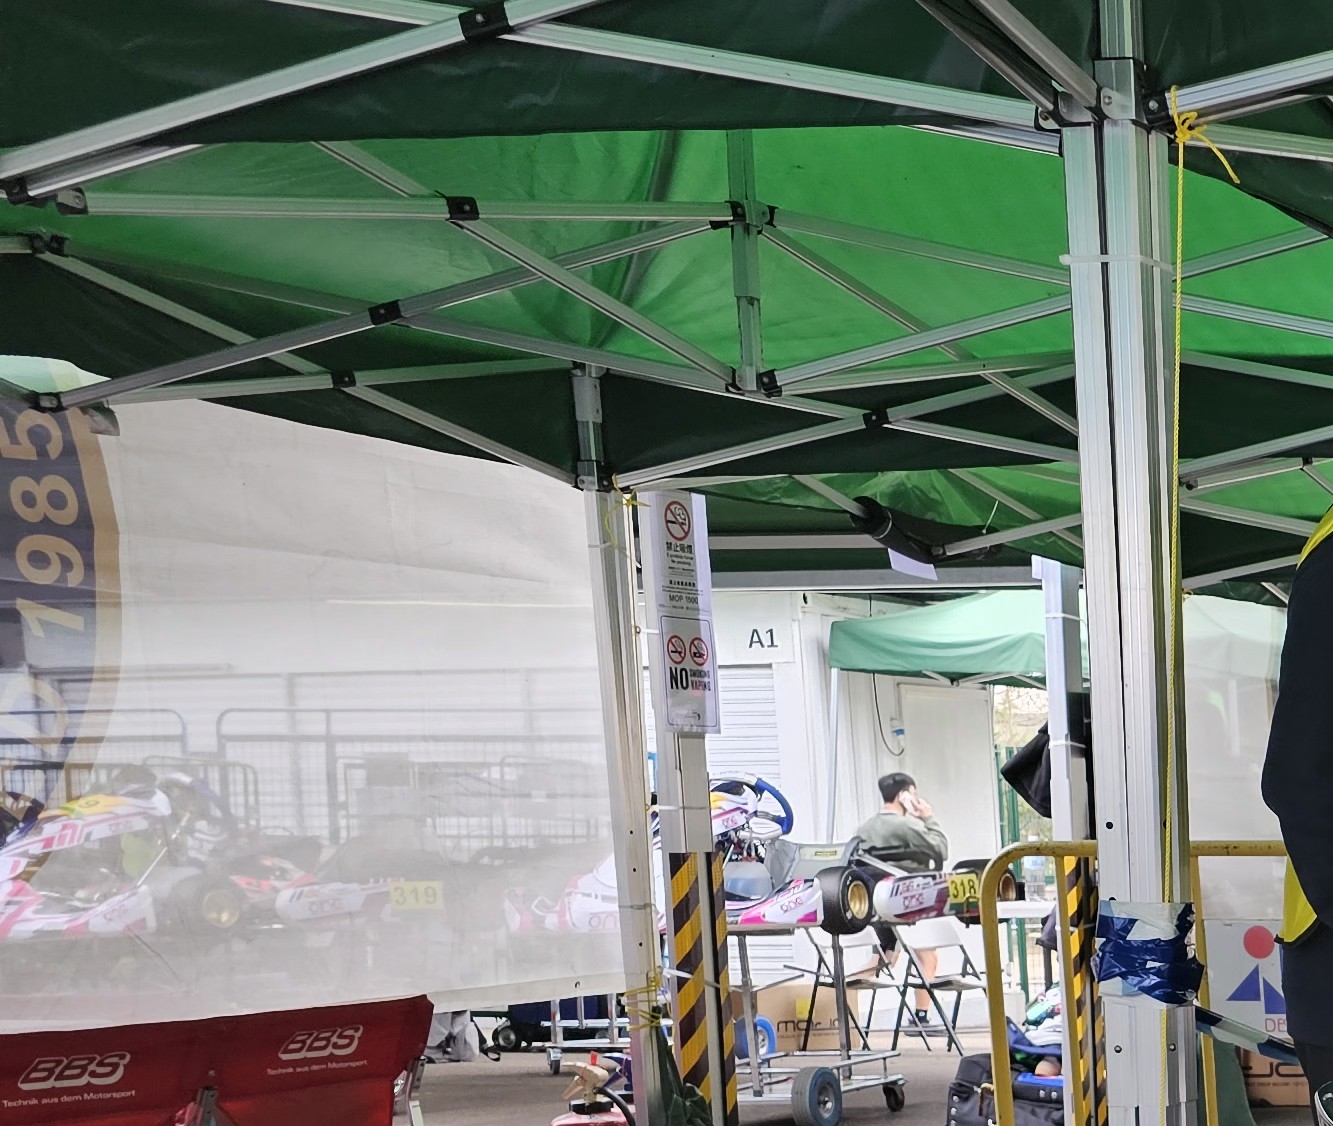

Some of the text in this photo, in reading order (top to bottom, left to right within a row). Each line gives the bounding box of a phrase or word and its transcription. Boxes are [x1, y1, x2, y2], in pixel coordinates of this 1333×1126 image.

[0, 408, 84, 638] 1985
[748, 628, 779, 649] A1
[669, 666, 689, 690] NO
[393, 886, 438, 906] 319
[950, 880, 978, 899] 318
[278, 1025, 364, 1060] BBS
[18, 1051, 131, 1091] BBS
[328, 1060, 368, 1068] Motorsport
[3, 1099, 39, 1107] Technik
[60, 1094, 82, 1102] dem
[83, 1090, 136, 1099] Motorsport
